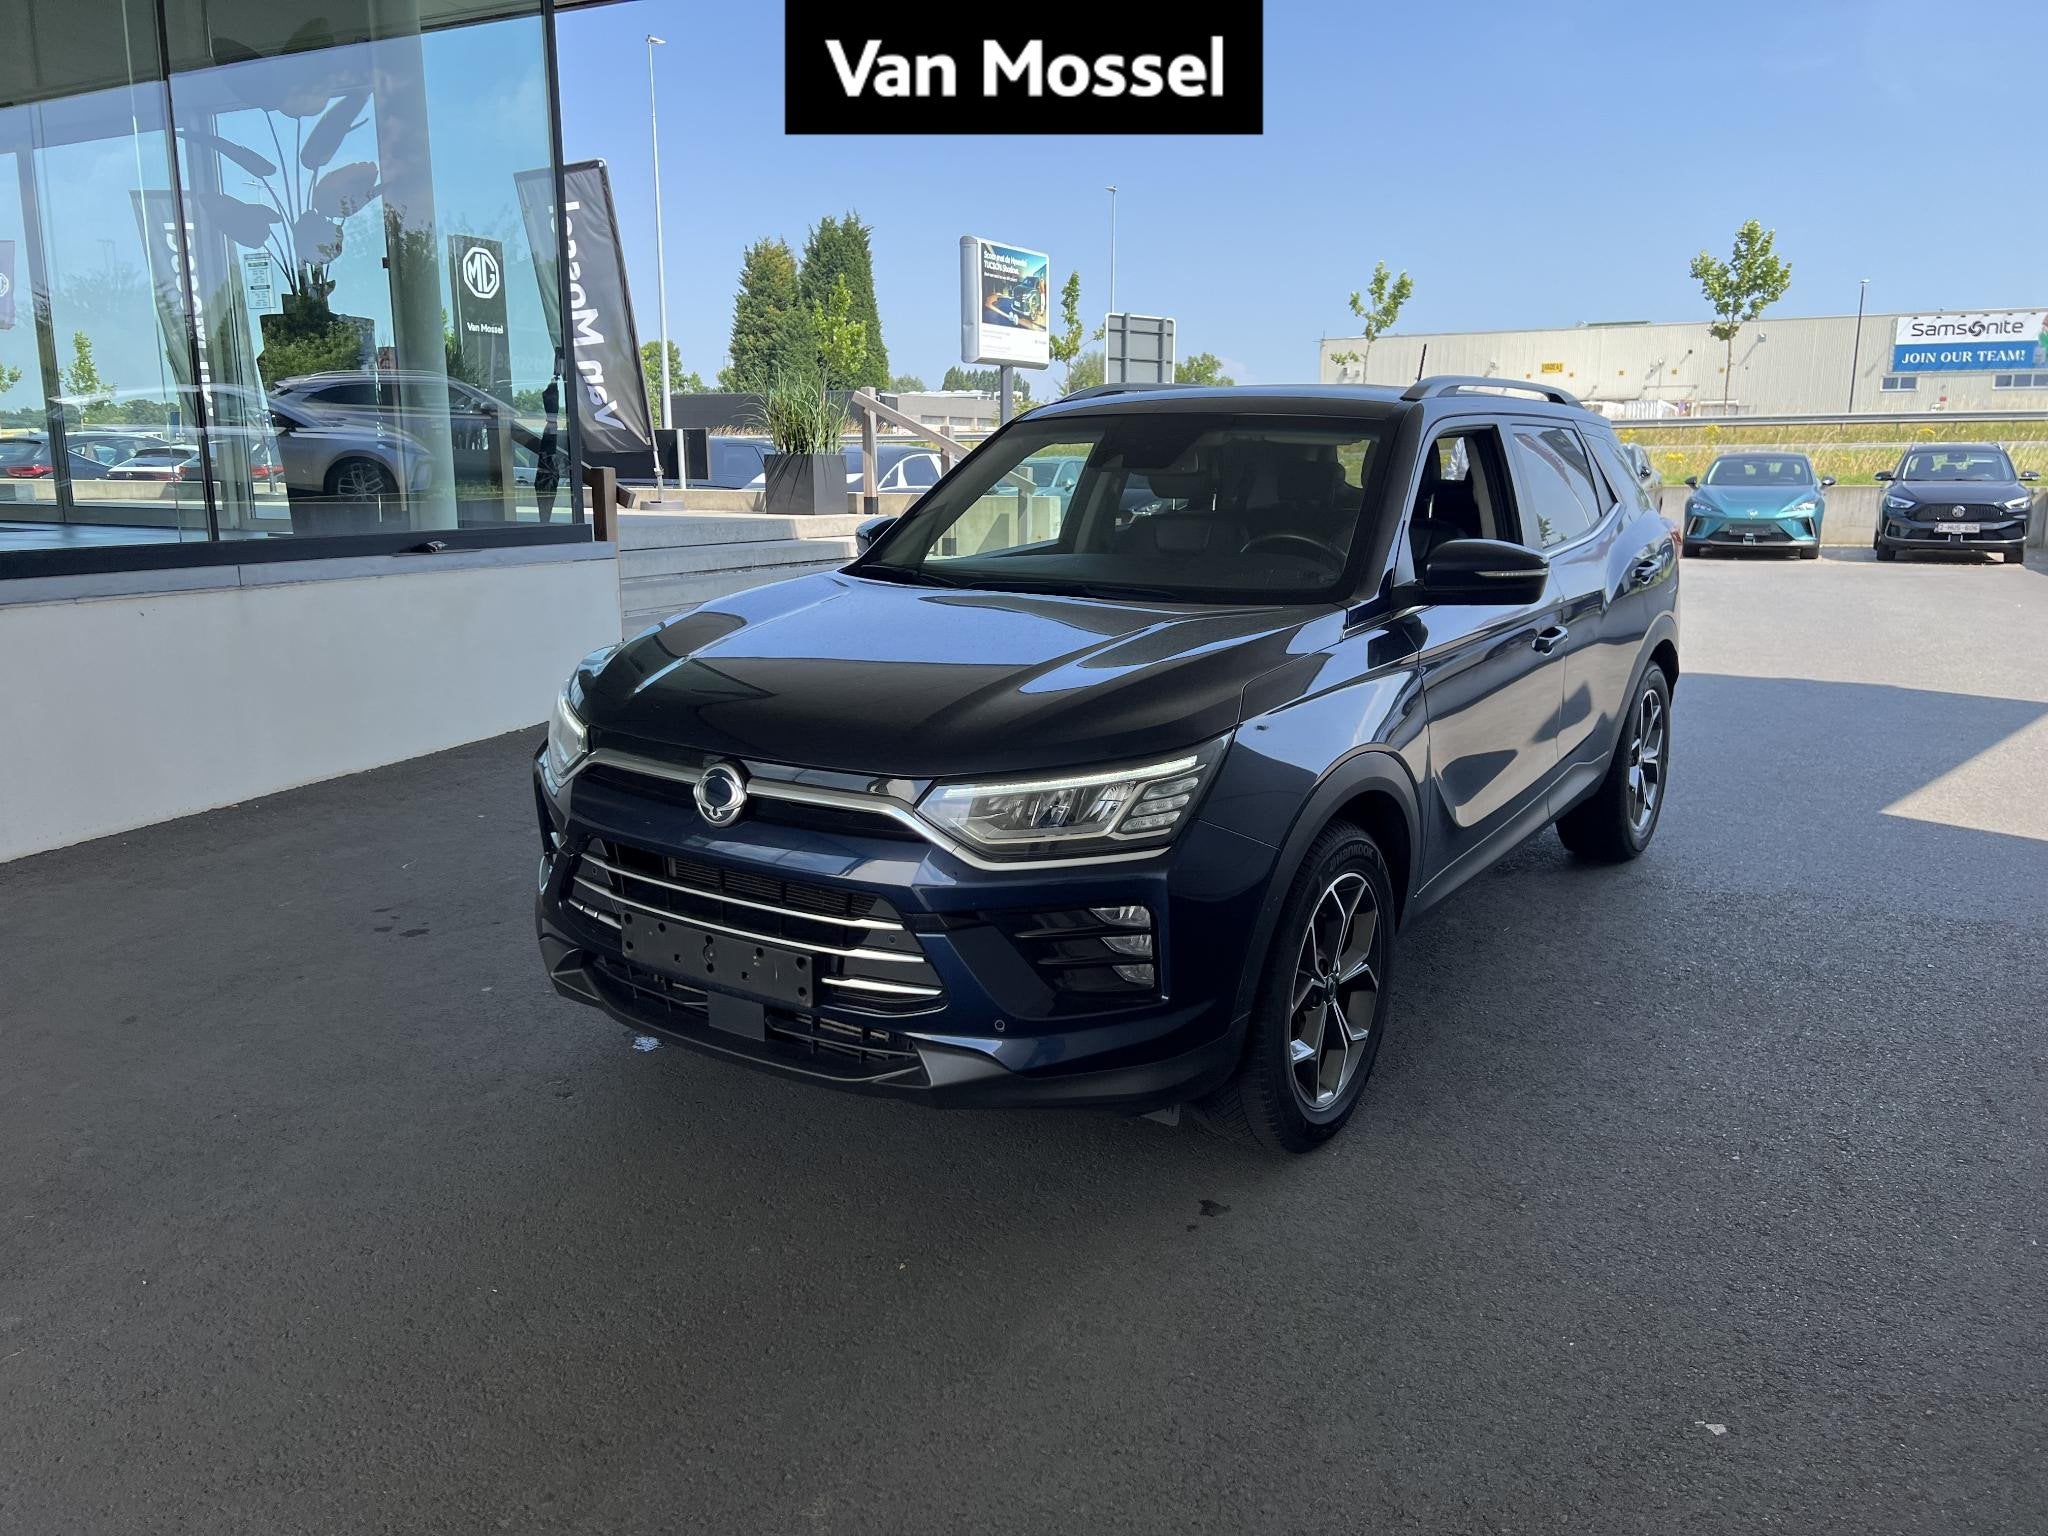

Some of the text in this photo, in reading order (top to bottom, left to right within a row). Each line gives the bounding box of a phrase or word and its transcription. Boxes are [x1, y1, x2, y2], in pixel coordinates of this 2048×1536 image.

[465, 250, 497, 295] MG
[467, 321, 479, 332] Van
[1911, 320, 2024, 337] Samsonite
[1901, 350, 2026, 364] JOIN OUR TEAM!
